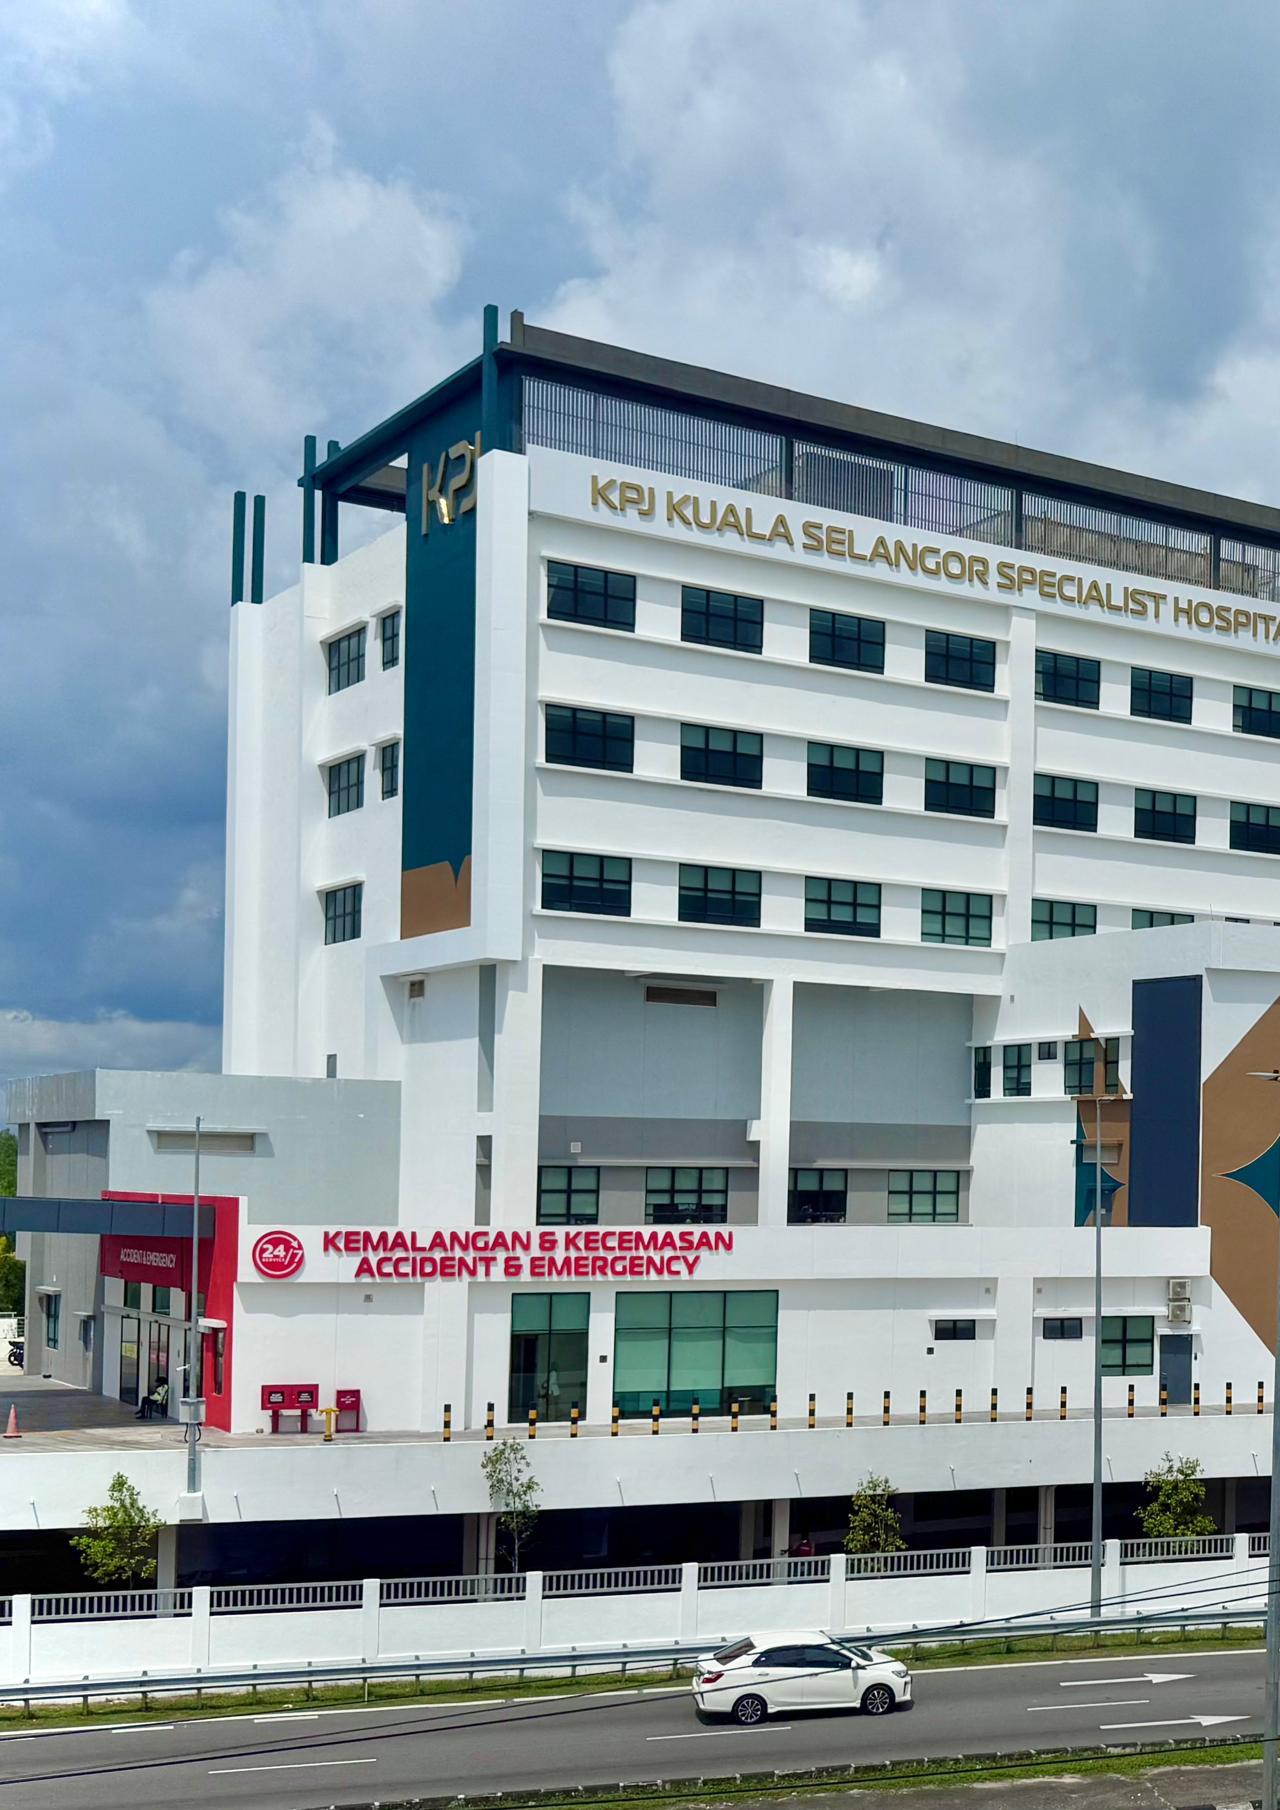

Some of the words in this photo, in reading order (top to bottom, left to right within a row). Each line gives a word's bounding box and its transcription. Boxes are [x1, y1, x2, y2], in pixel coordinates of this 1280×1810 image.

[421, 430, 481, 536] KPJ
[591, 475, 655, 517] KPJ
[666, 491, 794, 546] KUALA
[802, 520, 989, 586] SELANGOR
[997, 561, 1167, 619] SPECIALIST
[323, 1230, 531, 1252] KEMALANGAN
[538, 1231, 558, 1251] &
[564, 1231, 733, 1251] KECEMASAN
[120, 1247, 142, 1264] ACCIDENT
[146, 1251, 177, 1268] EMERGENCY
[354, 1256, 498, 1278] ACCIDENT
[503, 1256, 523, 1277] &
[530, 1255, 701, 1277] EMERGENCY
